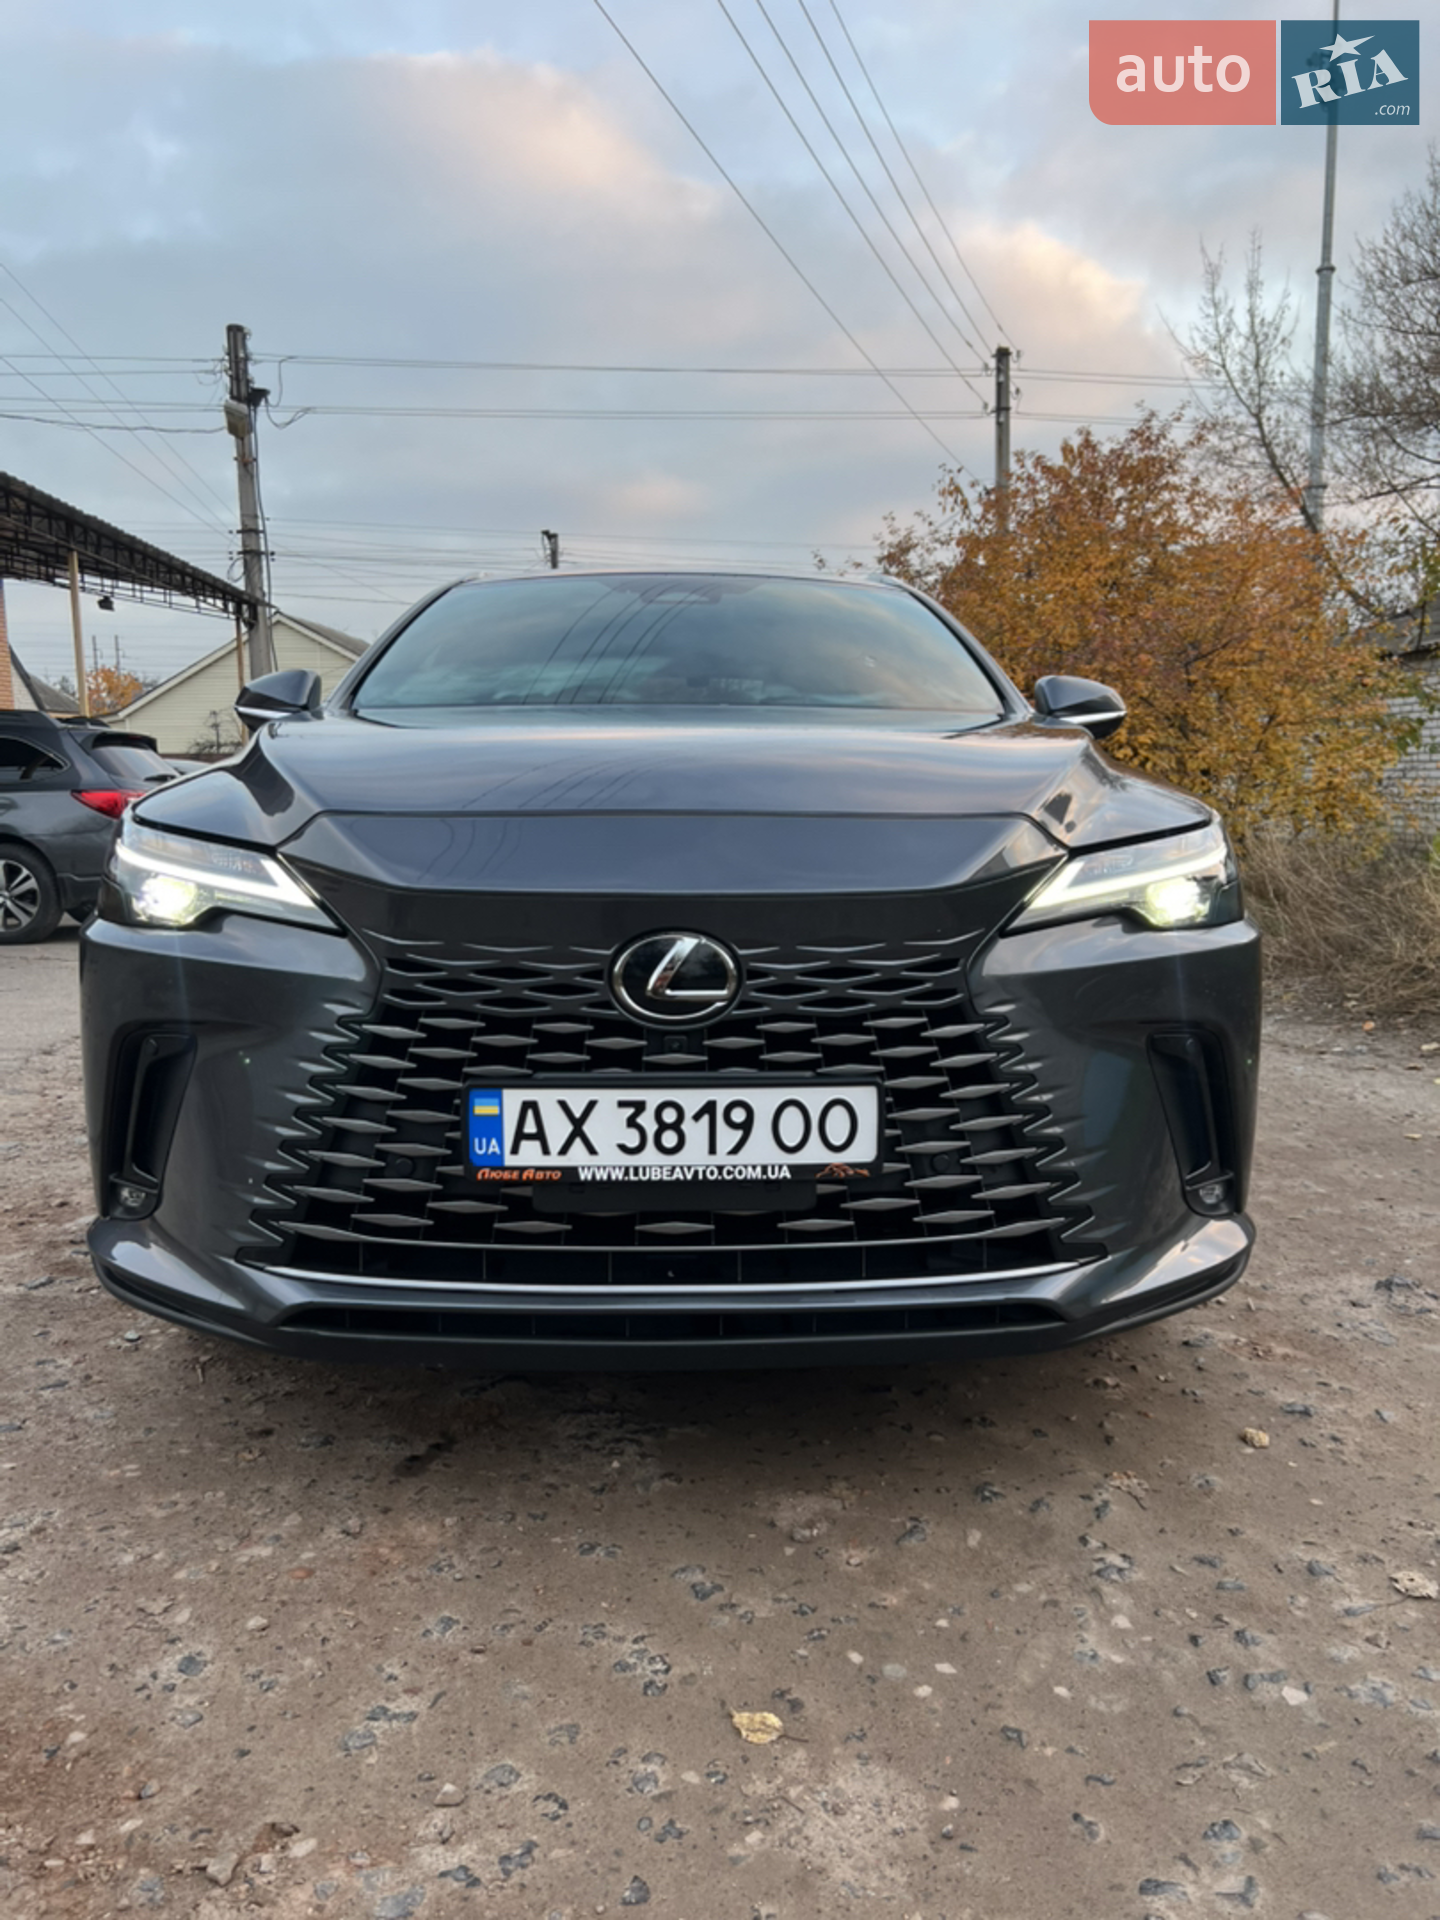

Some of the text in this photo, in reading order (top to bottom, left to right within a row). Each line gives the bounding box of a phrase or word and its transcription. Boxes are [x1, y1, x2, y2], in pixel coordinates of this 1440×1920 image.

[509, 1098, 600, 1157] AX
[615, 1098, 756, 1157] 3819
[473, 1137, 502, 1156] UA
[577, 1164, 792, 1181] WWW.LUBEAVTO.COM.UA
